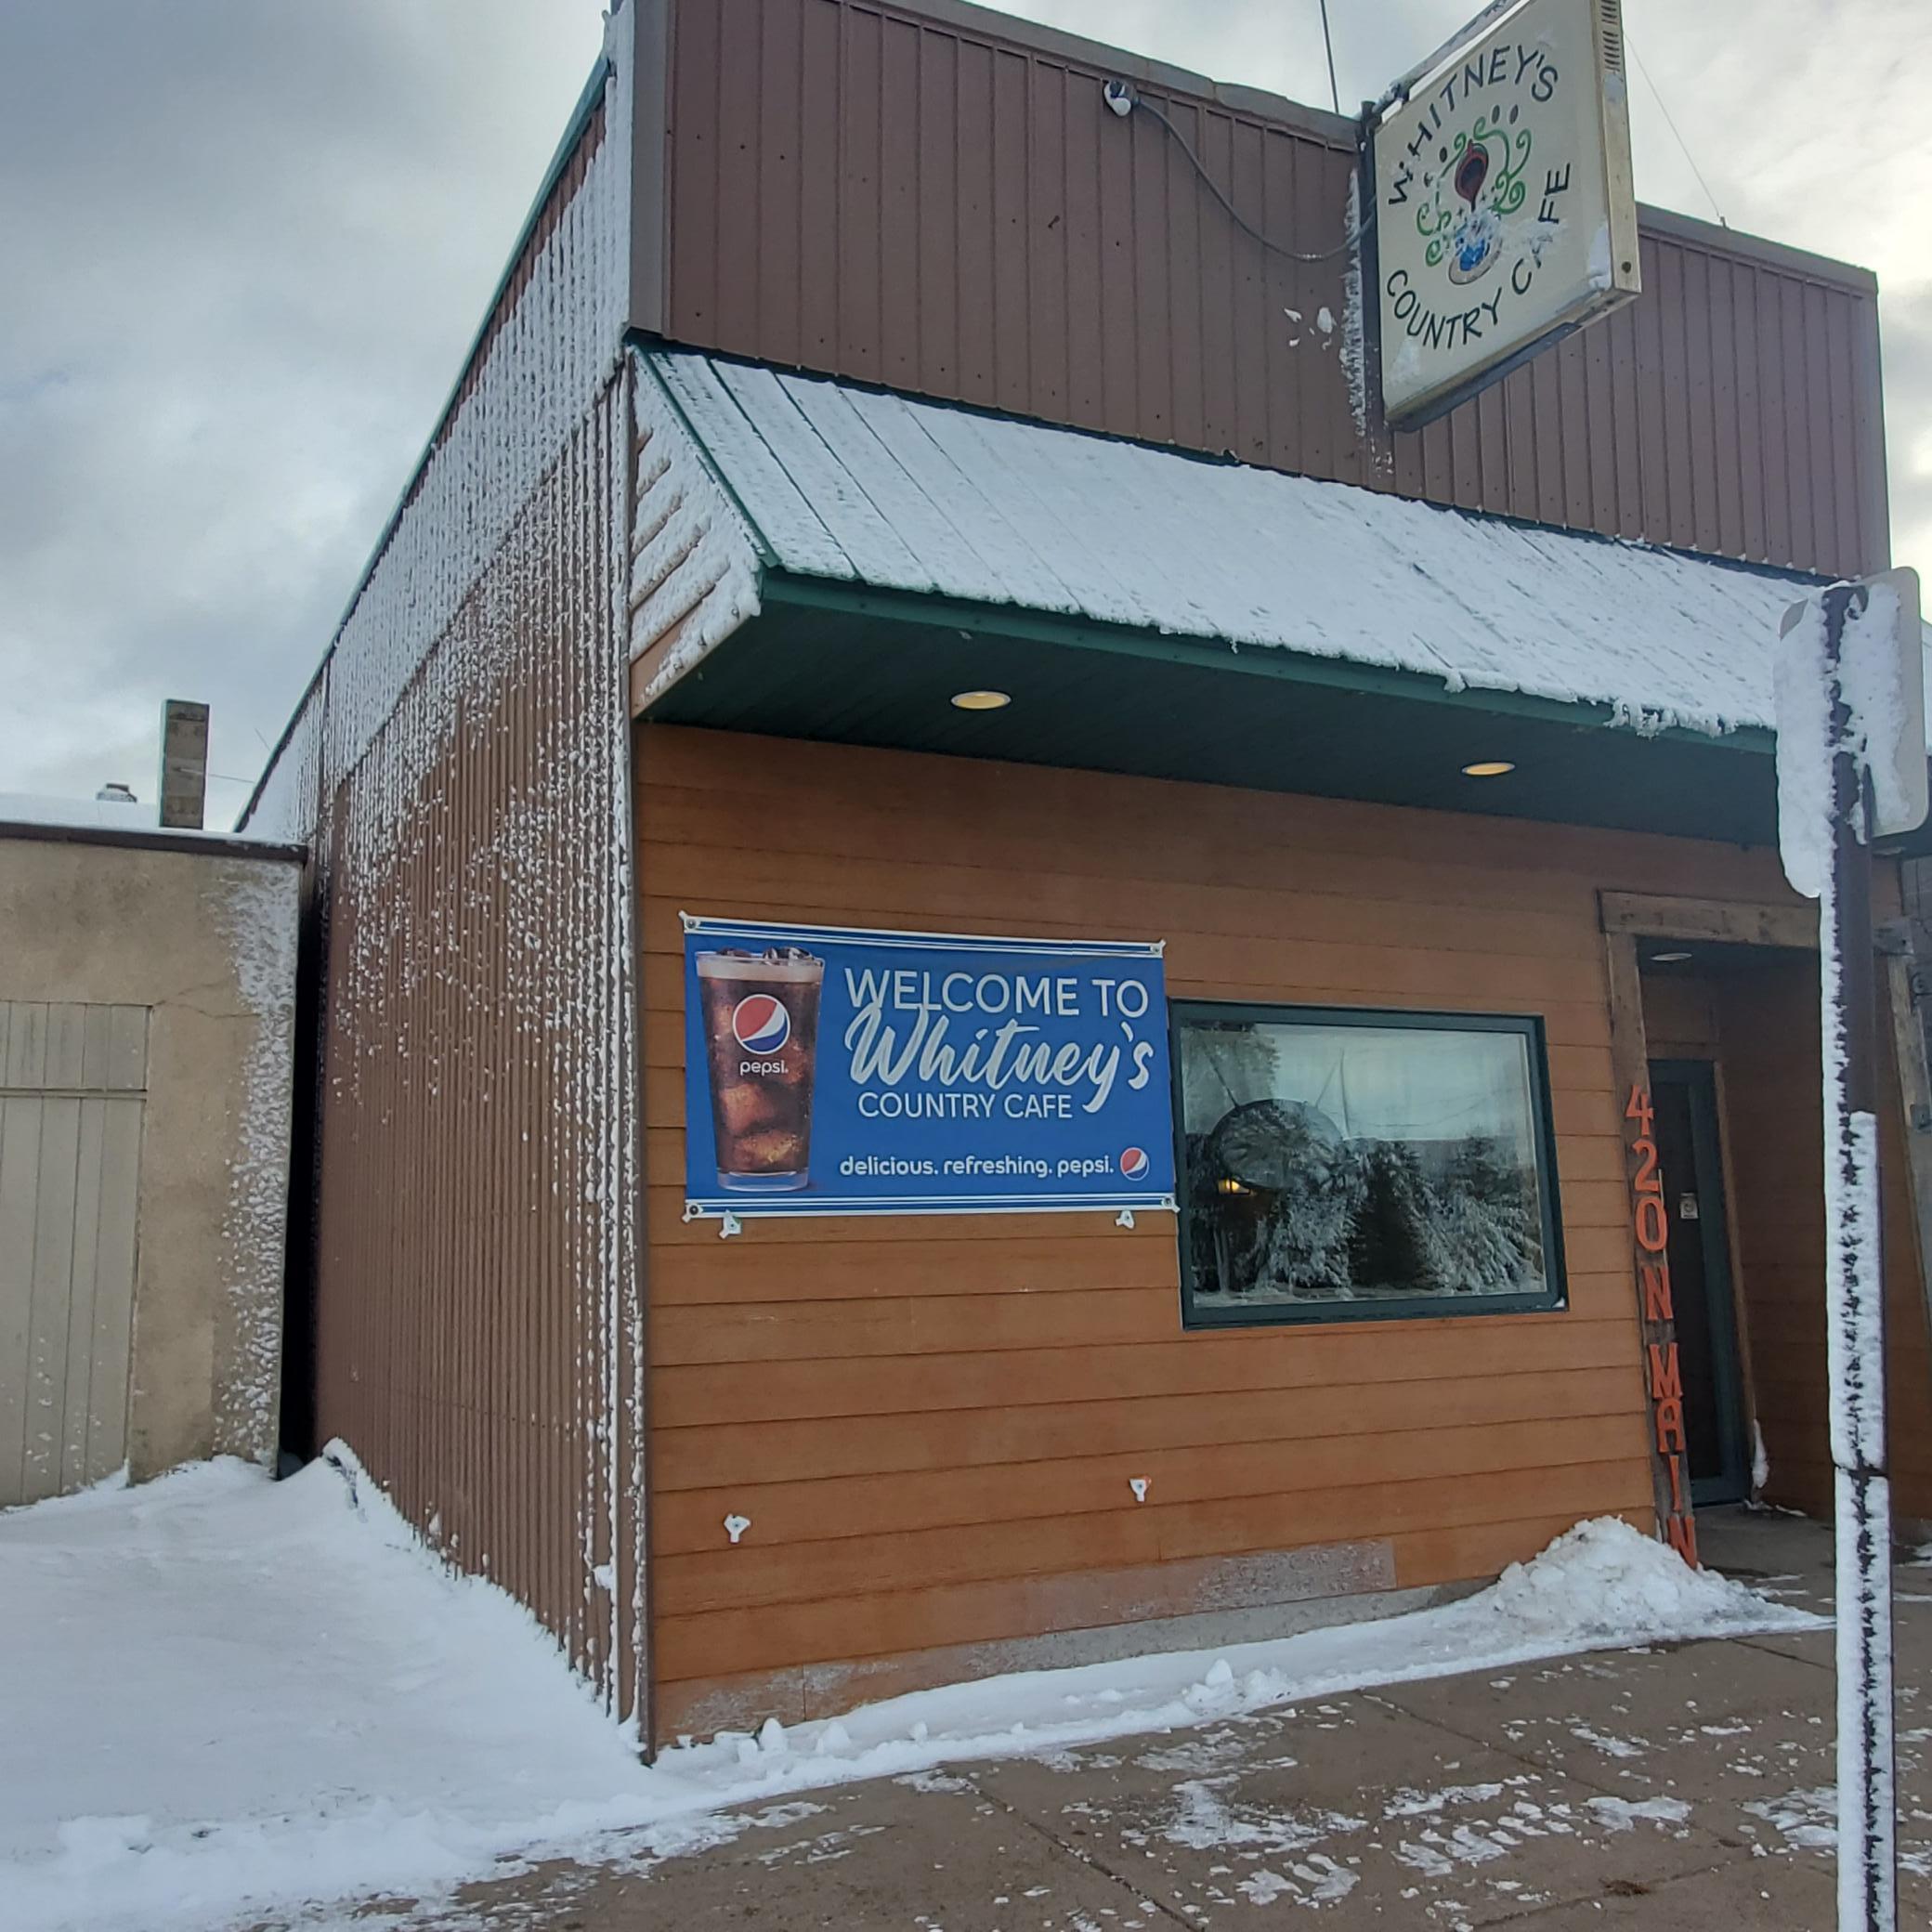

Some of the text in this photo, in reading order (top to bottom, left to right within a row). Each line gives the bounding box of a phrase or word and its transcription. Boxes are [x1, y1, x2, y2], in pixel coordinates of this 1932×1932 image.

[1388, 45, 1559, 205] WHITNEY'S
[1387, 269, 1502, 350] COUNTRY
[844, 968, 1149, 1018] WELCOME TO
[844, 1002, 1154, 1114] Whitney's
[857, 1091, 1073, 1118] COUNTRY CAFE
[840, 1155, 1115, 1178] delicious. refreshing. pepsi.
[1625, 1085, 1667, 1252] 420
[1649, 1342, 1698, 1572] MAIN
